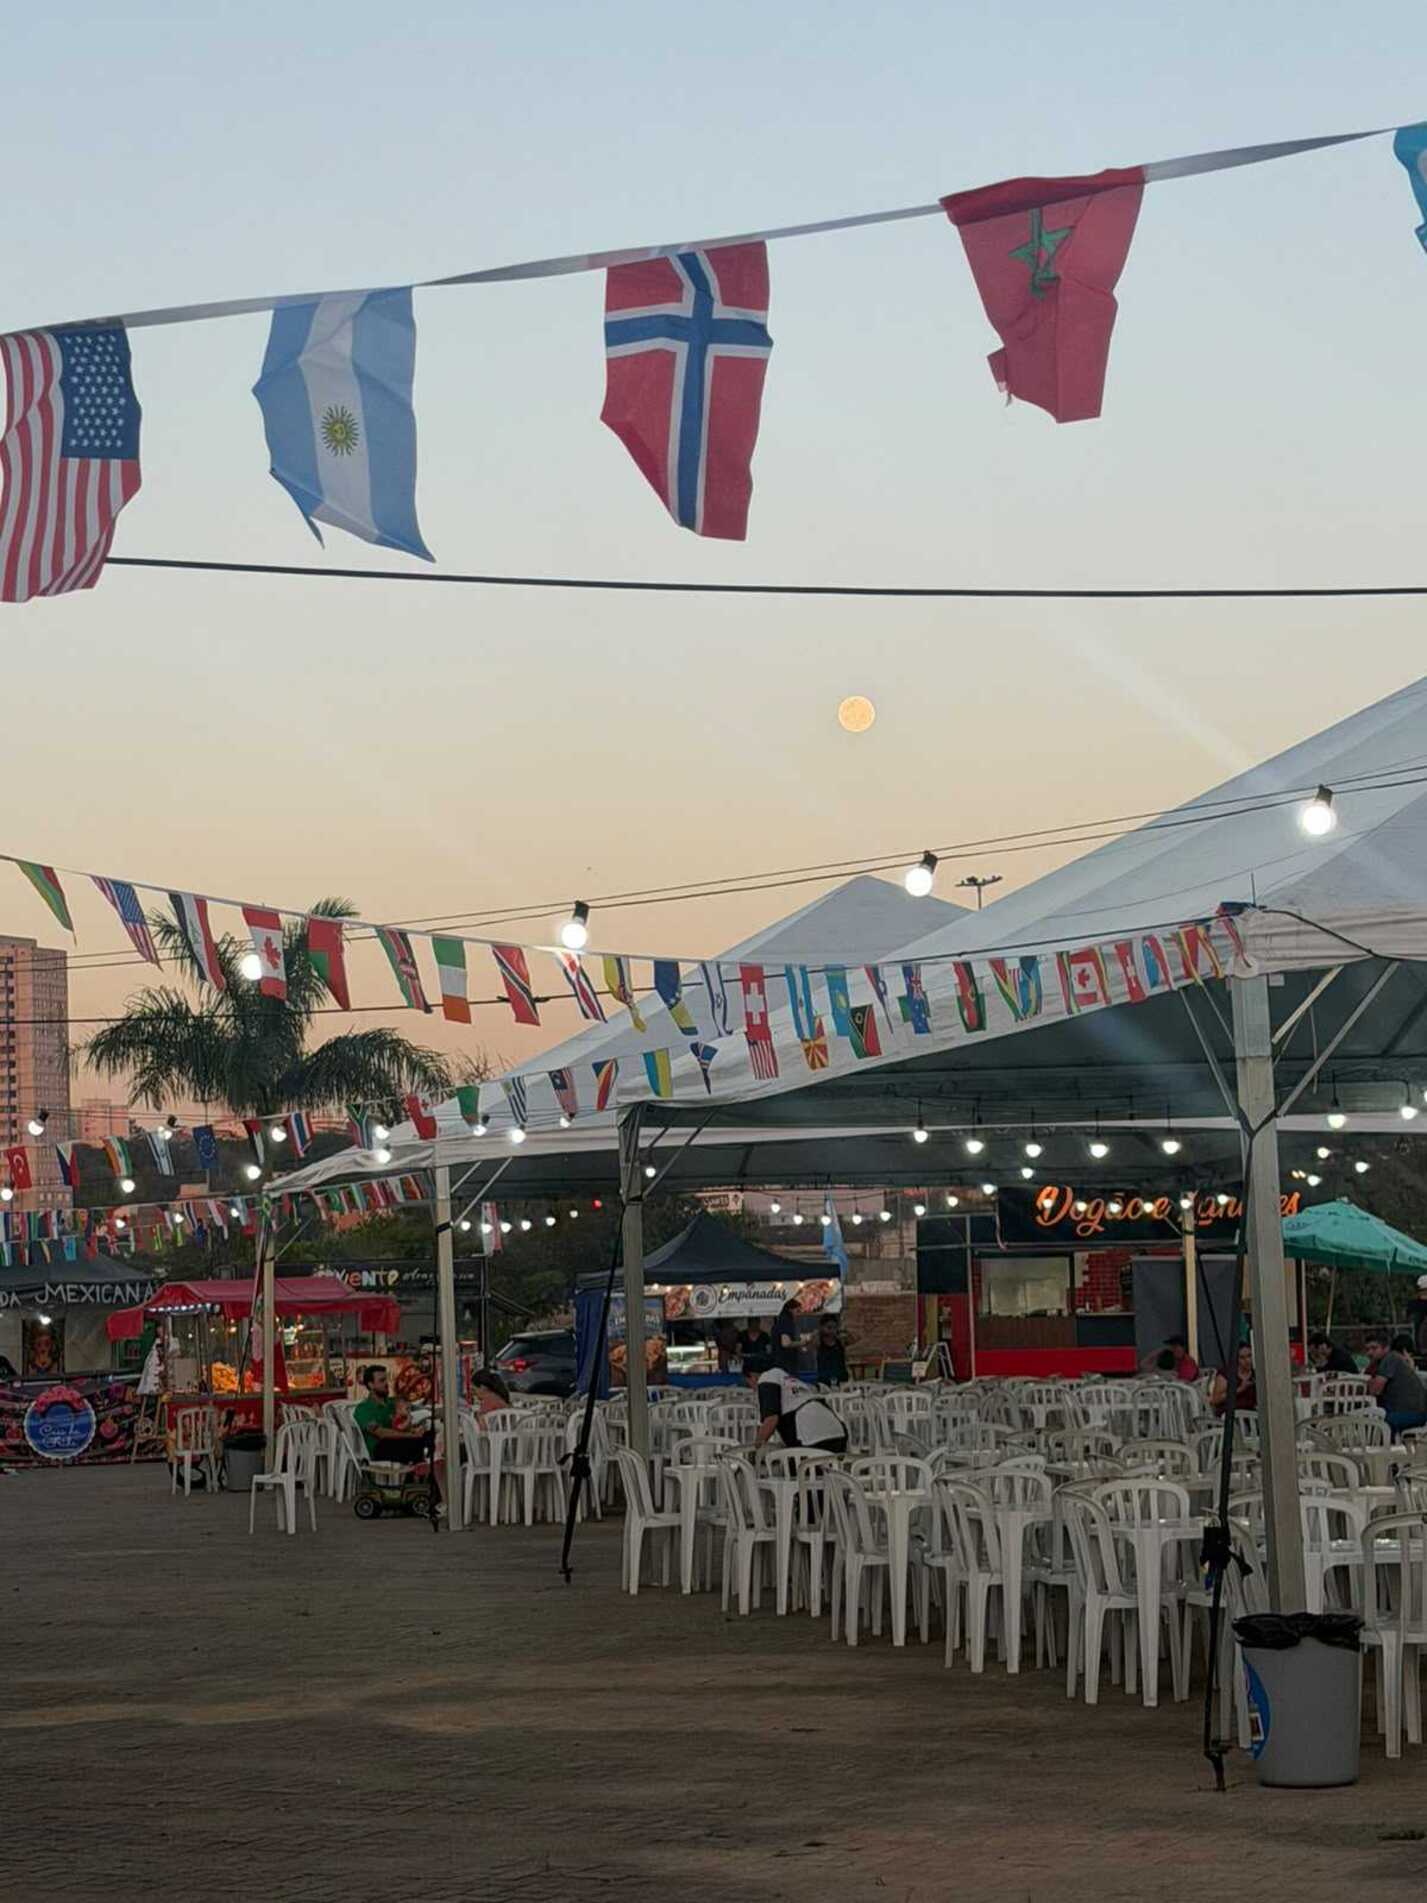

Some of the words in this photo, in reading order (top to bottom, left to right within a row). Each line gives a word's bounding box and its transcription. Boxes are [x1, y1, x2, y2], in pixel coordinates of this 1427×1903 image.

[1152, 1197, 1169, 1219] e
[35, 1281, 153, 1304] MEXICANA
[718, 1284, 786, 1304] Empanadas
